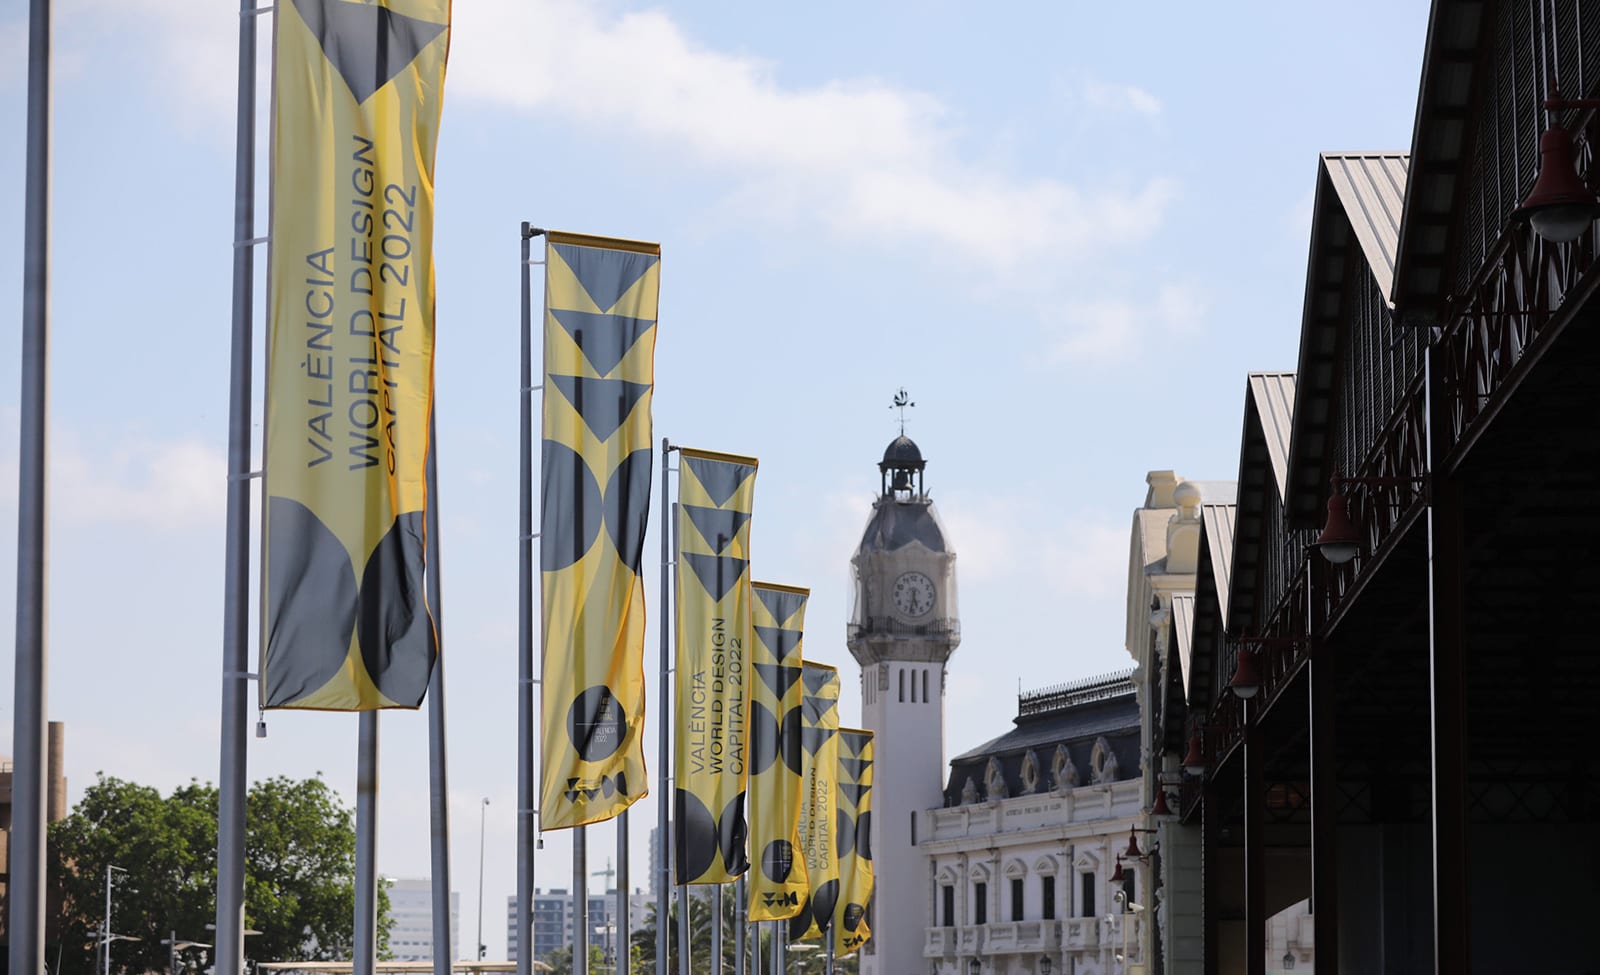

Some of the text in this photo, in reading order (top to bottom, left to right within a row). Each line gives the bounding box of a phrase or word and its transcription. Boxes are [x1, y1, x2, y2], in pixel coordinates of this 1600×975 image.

[301, 247, 335, 468] VALÈNCIA
[349, 135, 379, 471] WORLD DESIGN
[378, 184, 416, 476] CAPITAL 2022
[688, 671, 706, 775] VALÈNCIA
[710, 618, 726, 775] WORLD DESIGN
[729, 638, 744, 776] CAPITAL 2022
[808, 820, 818, 870] WORLD
[817, 780, 829, 871] CAPITAL 2022
